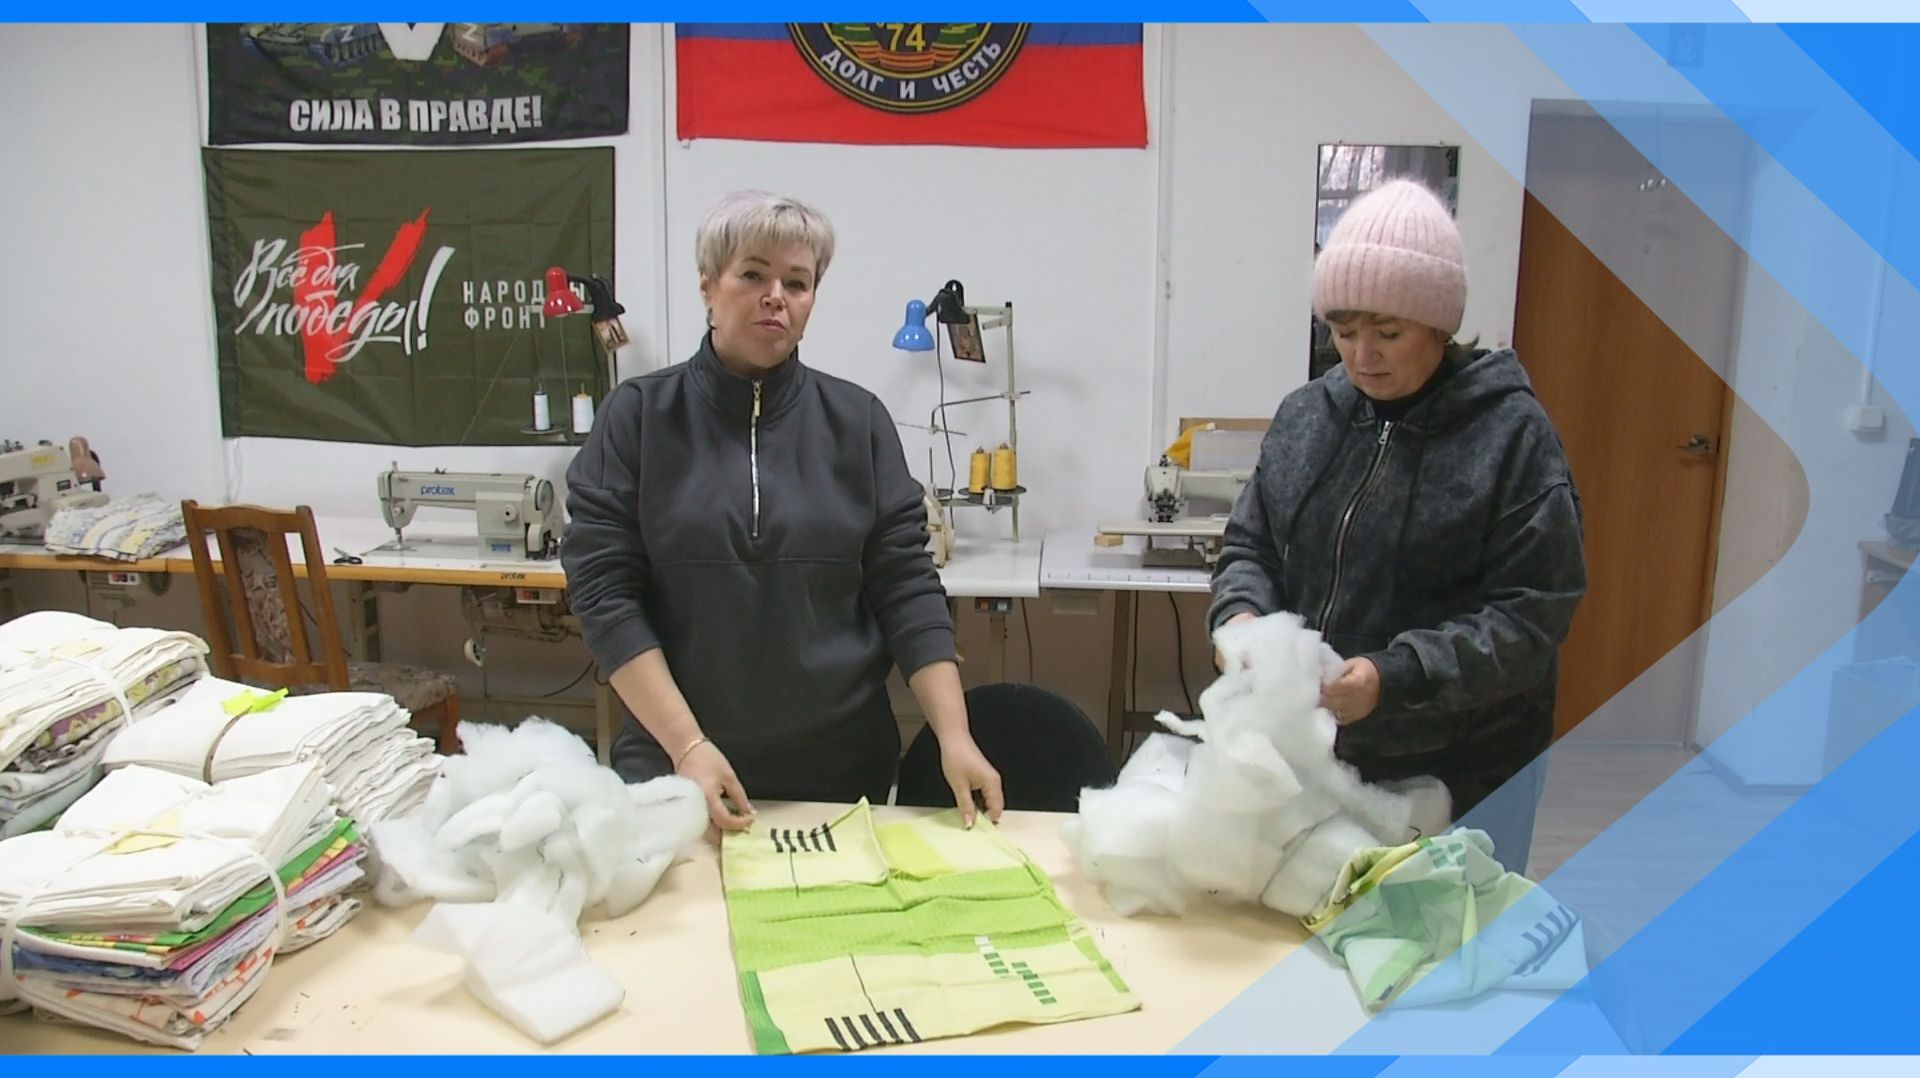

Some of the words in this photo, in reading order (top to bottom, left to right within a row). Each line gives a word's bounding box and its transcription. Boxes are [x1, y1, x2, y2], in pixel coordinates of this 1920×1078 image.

[886, 21, 926, 52] 74
[821, 49, 885, 93] ДОЛГ
[899, 80, 916, 100] И
[931, 42, 1002, 94] ЧЕСТЬ
[289, 98, 374, 132] СИЛА
[379, 97, 402, 131] В
[408, 94, 544, 135] ПРАВДЕ!
[233, 238, 307, 309] Всё
[286, 242, 366, 293] для
[234, 246, 456, 363] победы!
